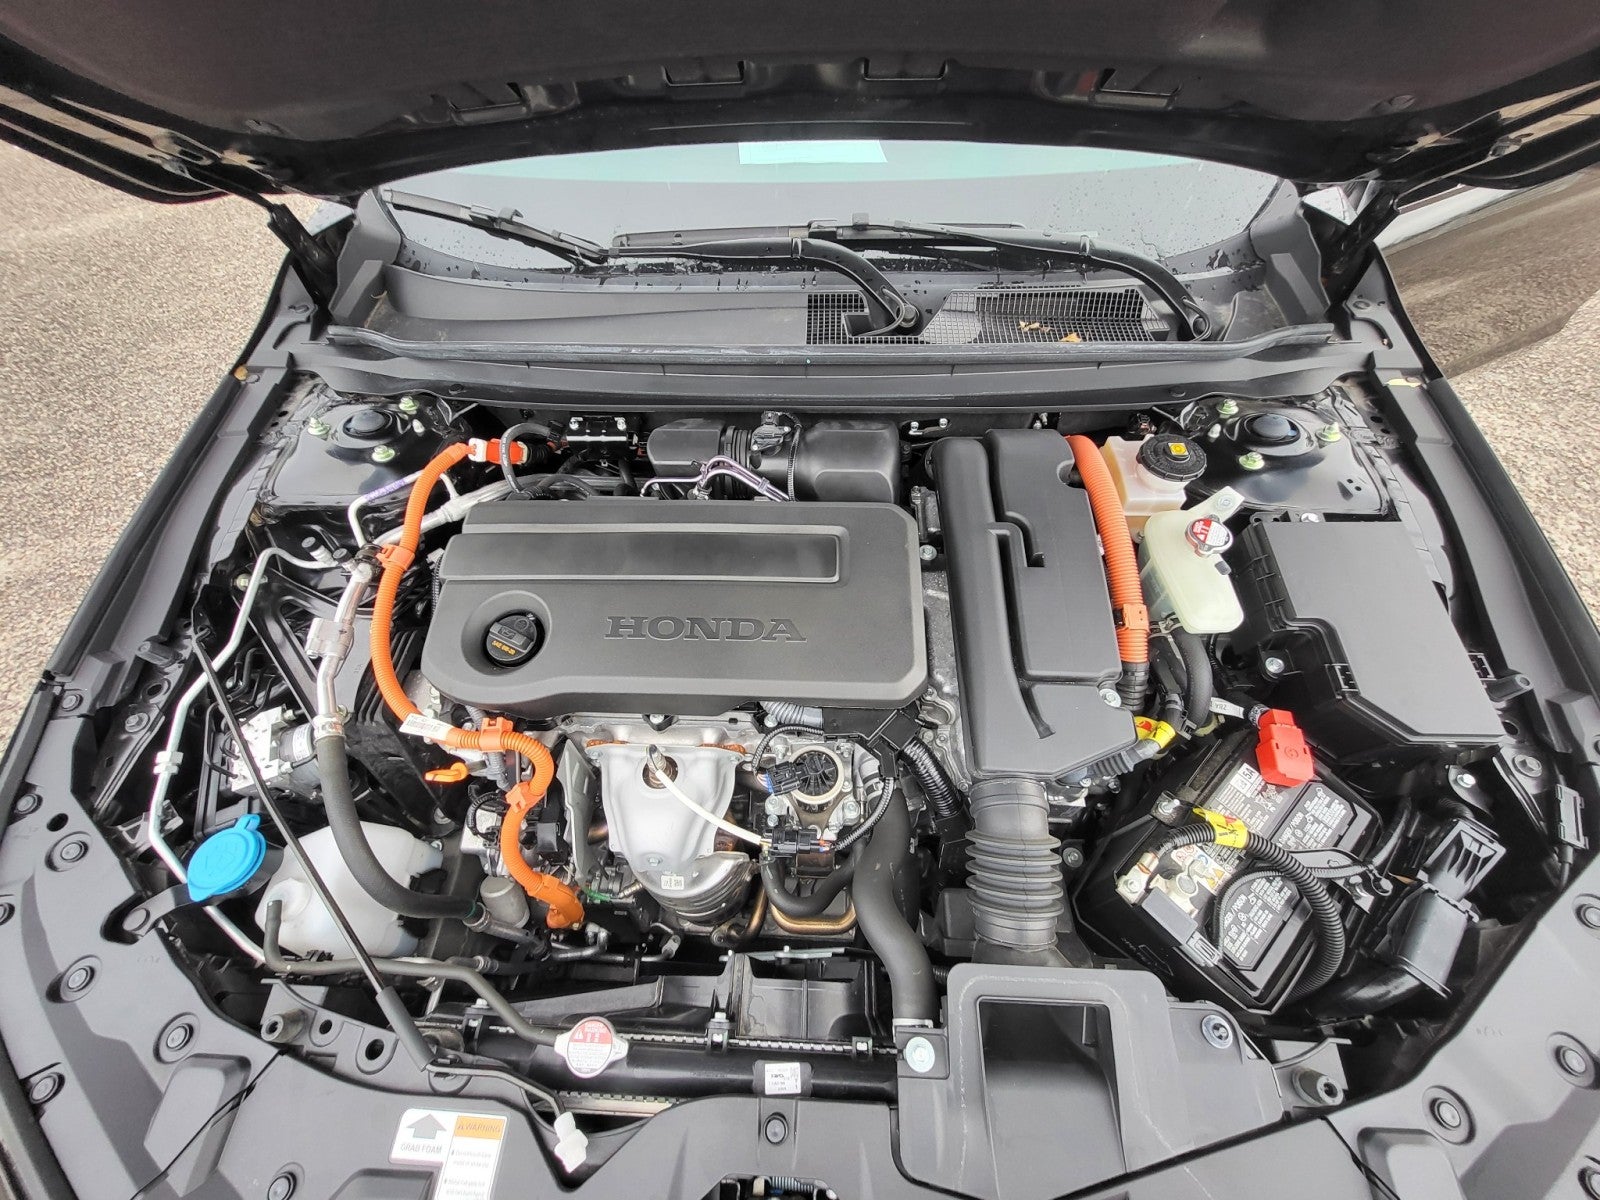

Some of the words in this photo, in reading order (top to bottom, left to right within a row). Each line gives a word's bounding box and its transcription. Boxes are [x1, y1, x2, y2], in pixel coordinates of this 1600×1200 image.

[604, 616, 808, 643] HONDA
[465, 1121, 501, 1133] WARNING
[400, 1142, 420, 1152] GRAB
[421, 1144, 442, 1154] FOAM
